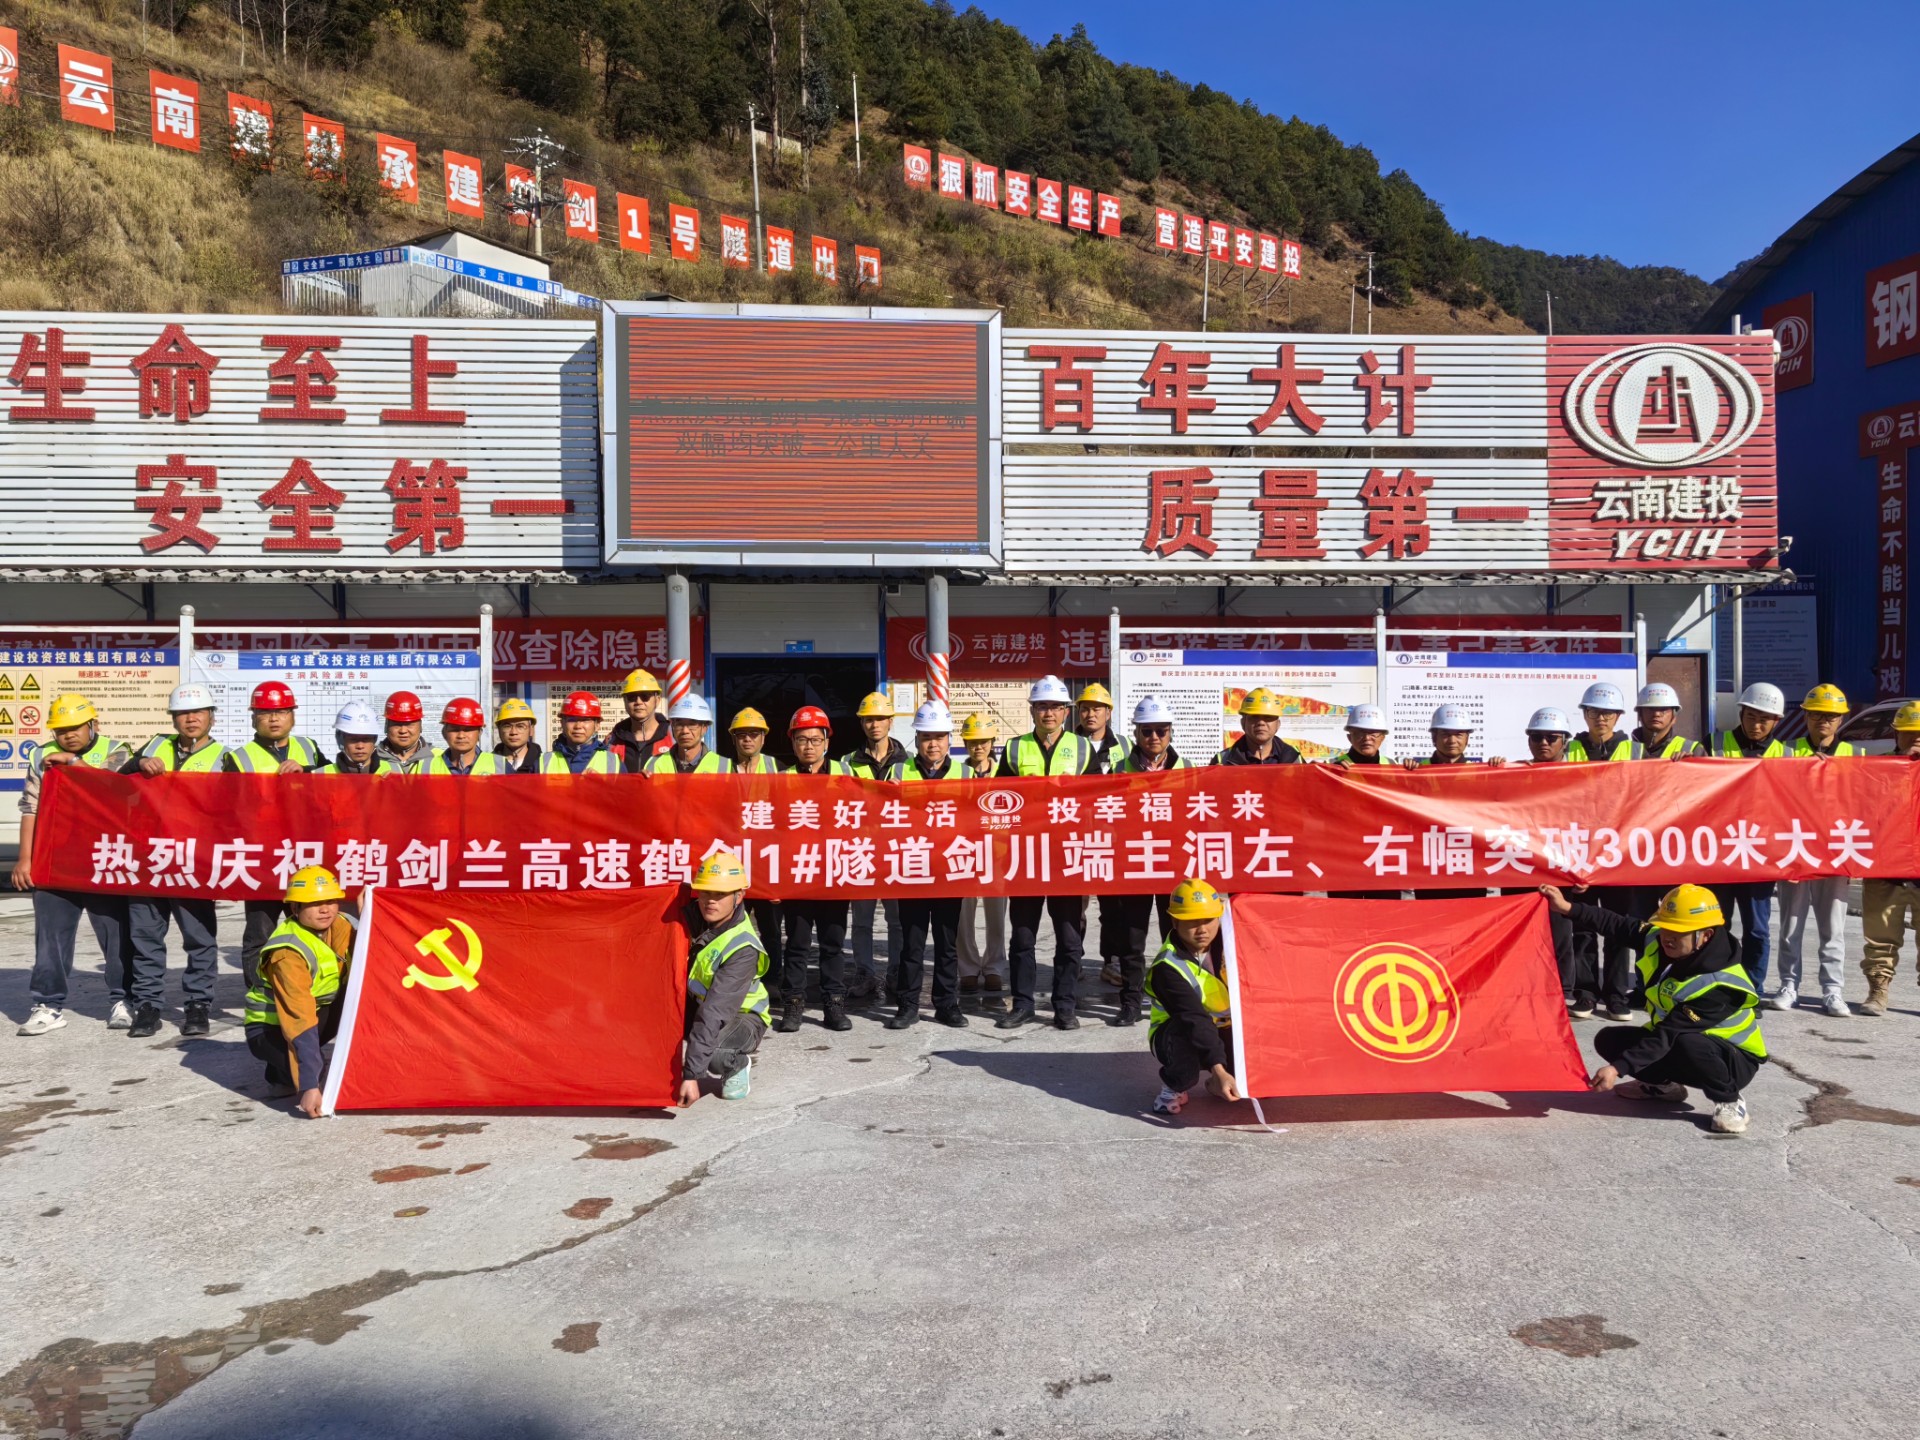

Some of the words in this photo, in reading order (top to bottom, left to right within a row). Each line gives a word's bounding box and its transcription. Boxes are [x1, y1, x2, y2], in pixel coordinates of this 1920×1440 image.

[941, 159, 1119, 230] 狠抓安全生产
[1158, 212, 1300, 275] 营造平安建投
[8, 323, 467, 422] 生命至上
[1028, 341, 1433, 435] 百年大计
[135, 453, 574, 553] 安全第一
[1144, 466, 1530, 558] 质量第一
[1594, 476, 1743, 521] 云南建投
[1614, 528, 1726, 558] YCIH
[1879, 461, 1903, 693] 生命不能当儿戏
[261, 654, 467, 666] 云南省建设投资控股集团有限公司
[971, 632, 1046, 651] 云南建投
[989, 652, 1029, 663] YCIH
[741, 799, 958, 830] 建美好生活
[1048, 790, 1266, 825] 投幸福未来
